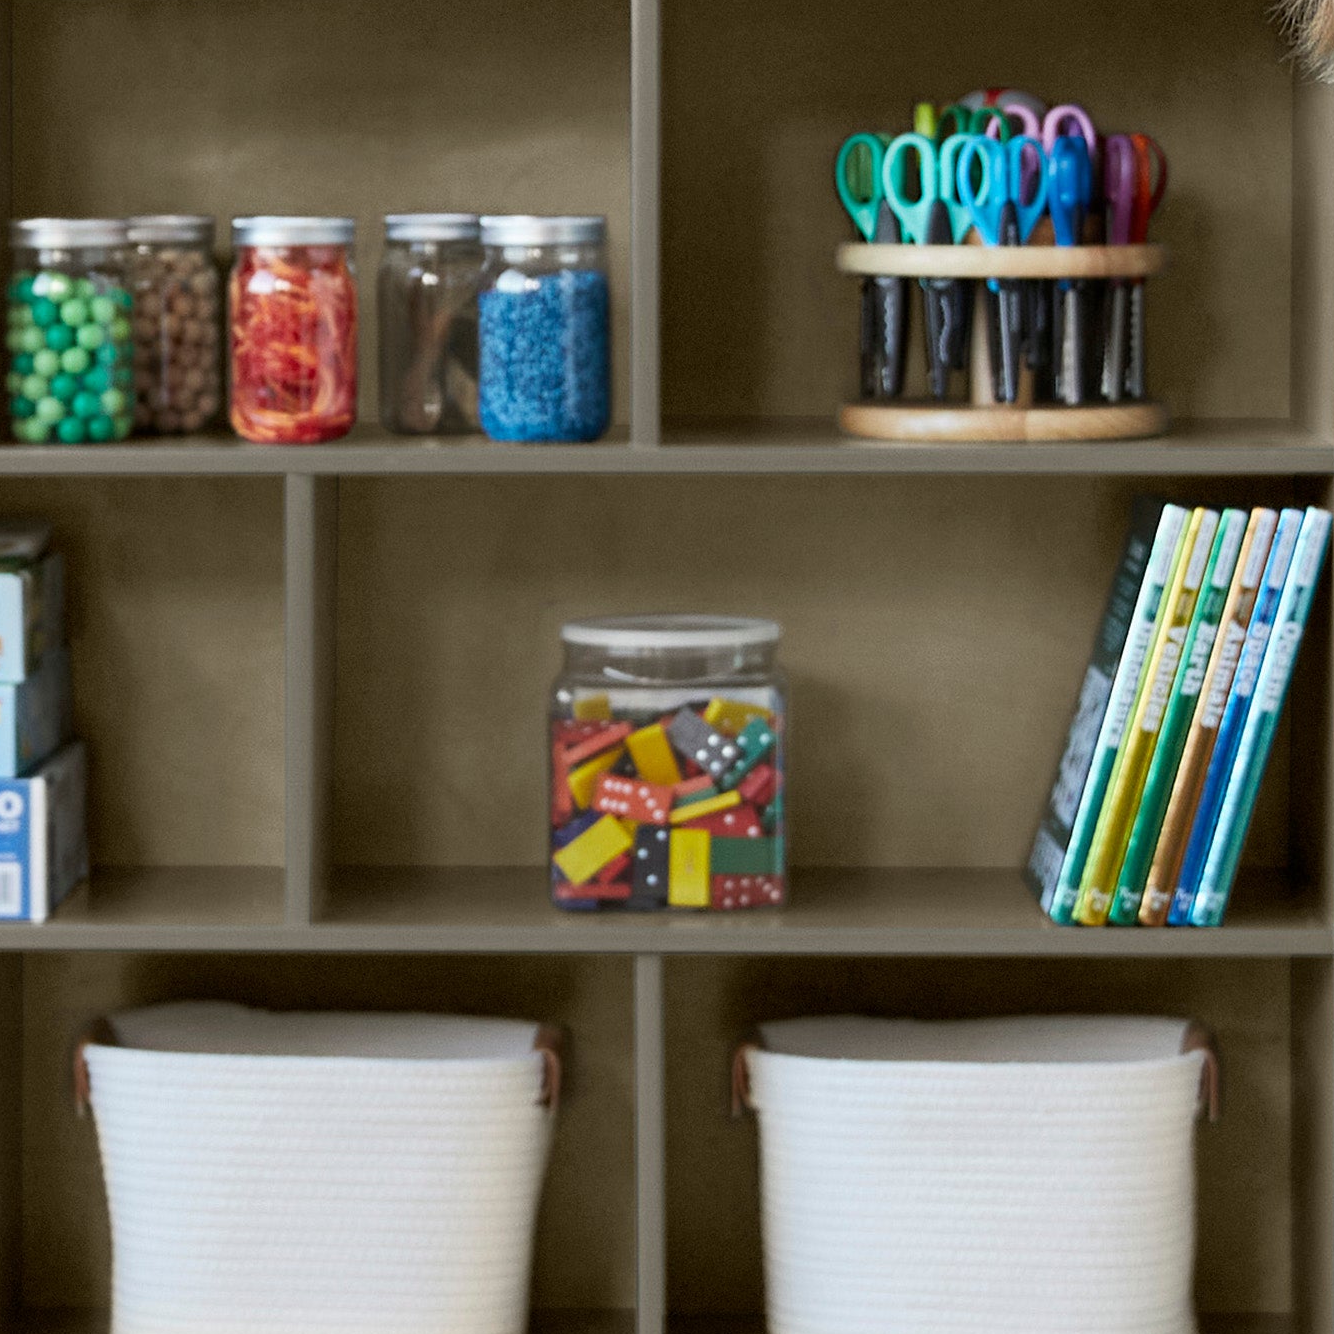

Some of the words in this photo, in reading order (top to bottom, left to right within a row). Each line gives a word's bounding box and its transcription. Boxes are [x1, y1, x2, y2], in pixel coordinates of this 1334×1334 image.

[1142, 626, 1188, 732] Vehicles
[1181, 621, 1217, 696] Earth
[1200, 620, 1245, 728] Animals
[1235, 621, 1271, 698] Space
[1260, 621, 1303, 713] Oceans
